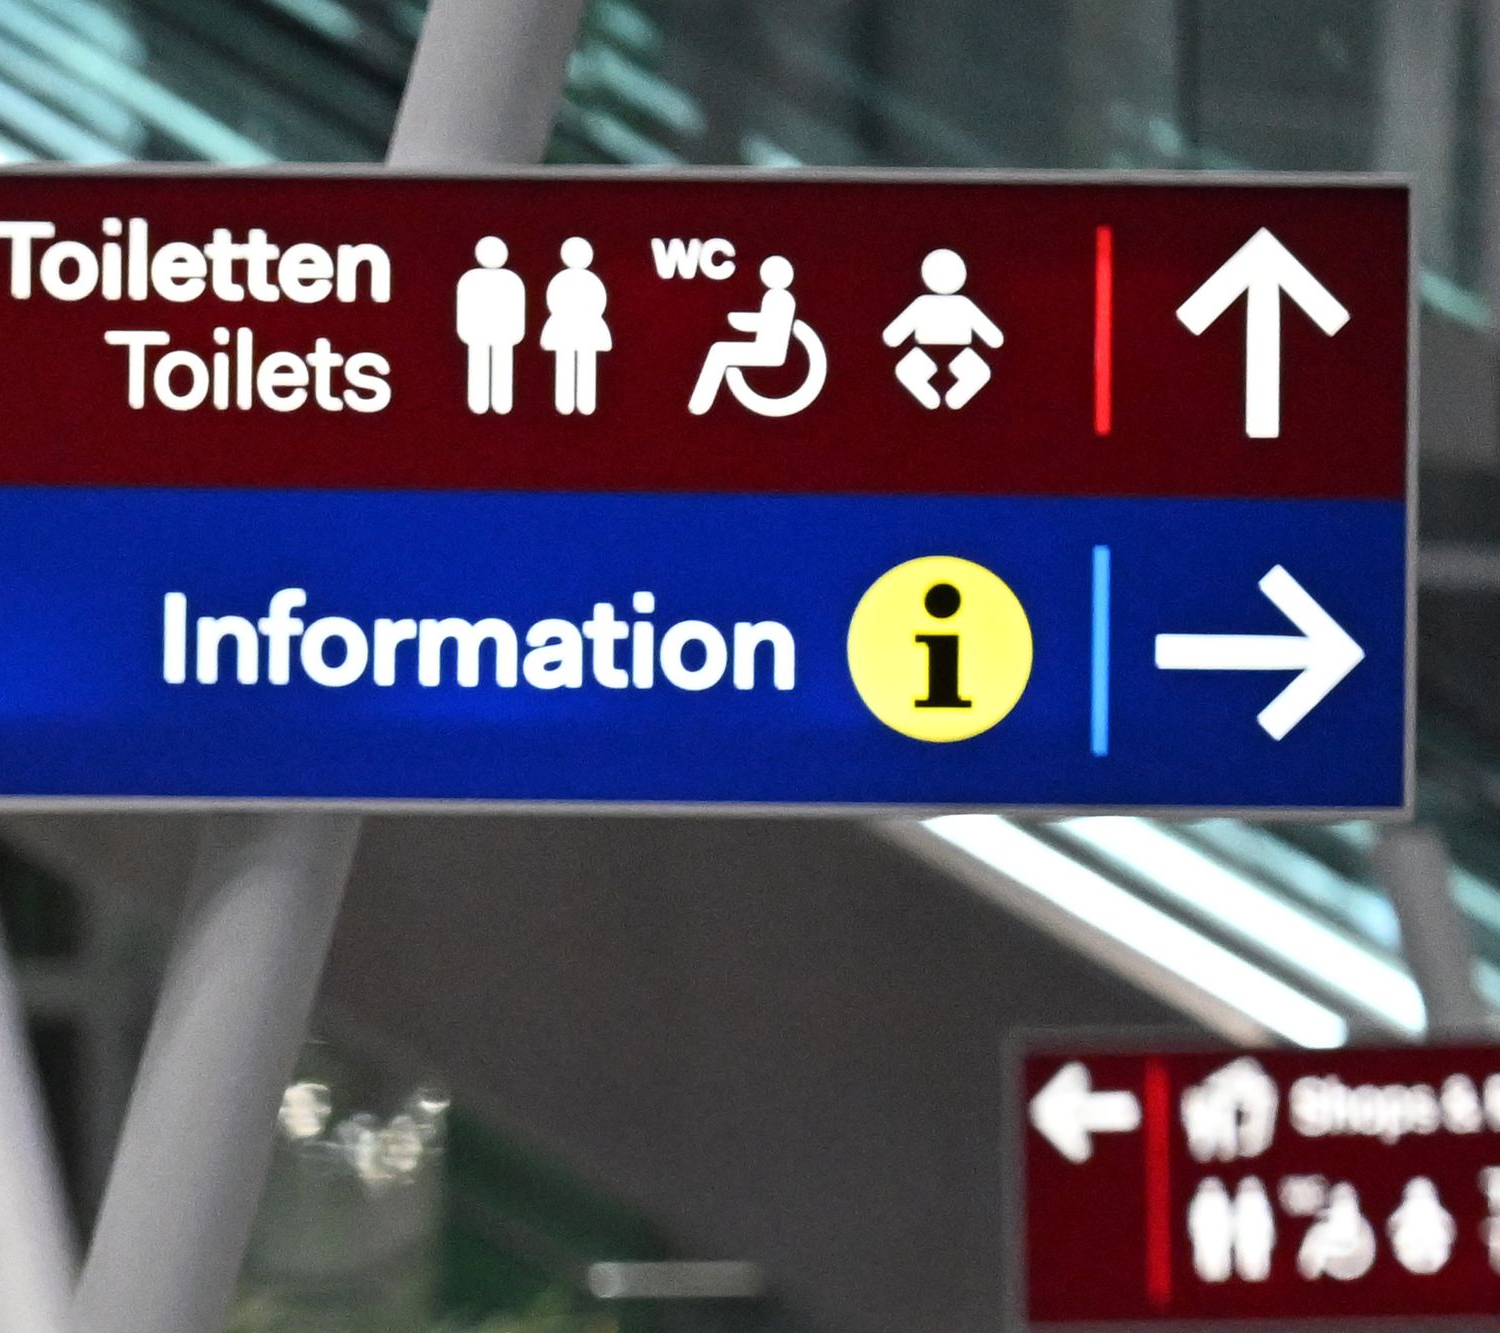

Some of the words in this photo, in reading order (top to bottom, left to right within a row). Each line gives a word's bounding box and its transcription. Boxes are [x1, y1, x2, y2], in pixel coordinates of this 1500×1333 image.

[650, 237, 736, 281] WC
[104, 326, 392, 413] Toilets
[163, 587, 796, 691] Information
